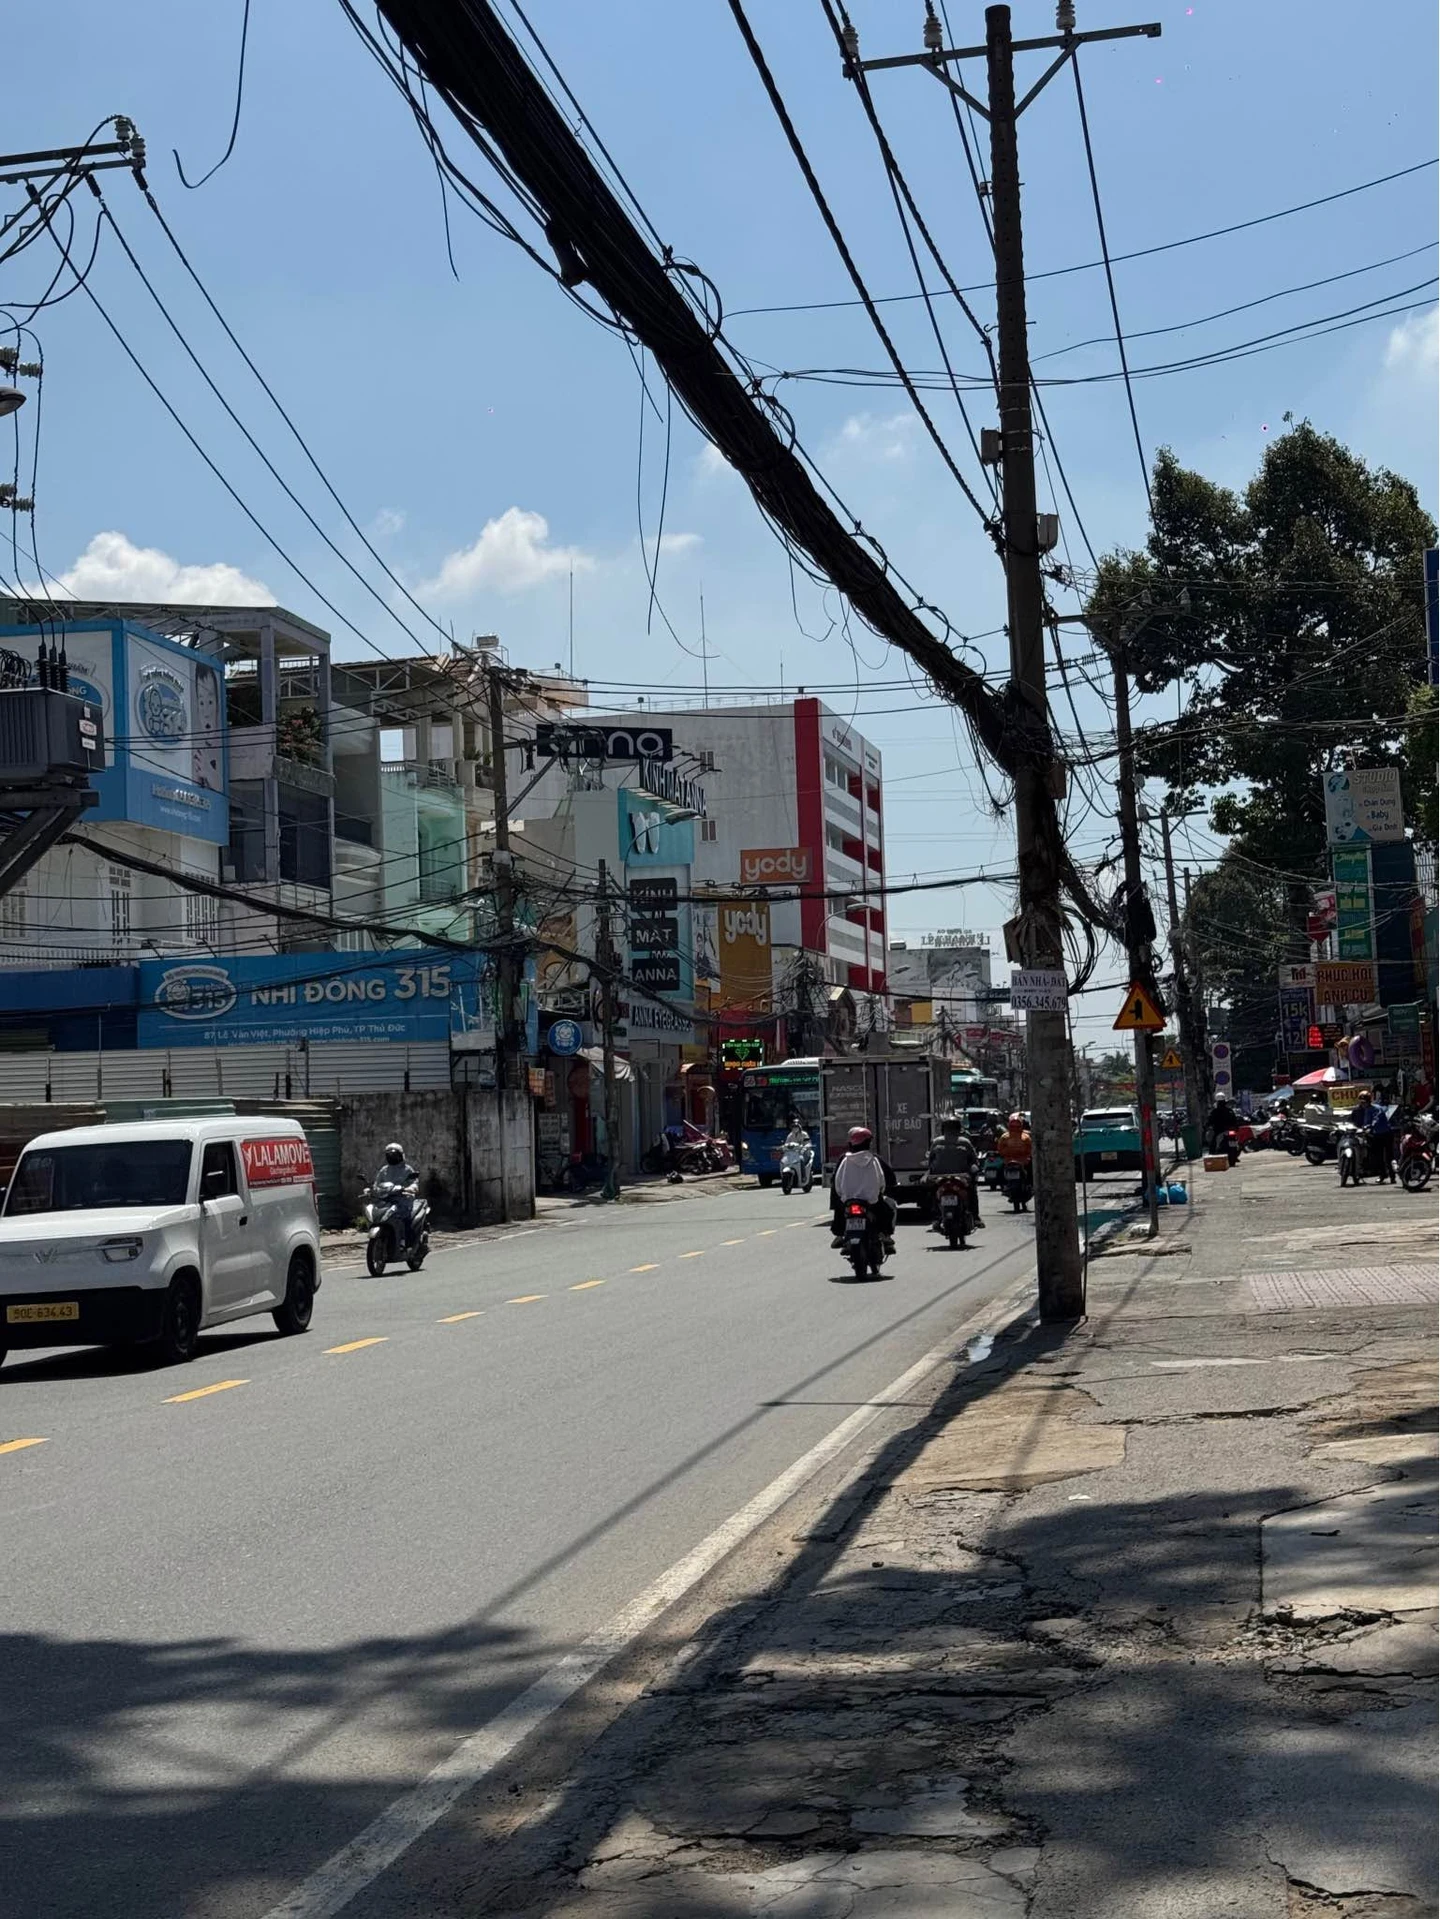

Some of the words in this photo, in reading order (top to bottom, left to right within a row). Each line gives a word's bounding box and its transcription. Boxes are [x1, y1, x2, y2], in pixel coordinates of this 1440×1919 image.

[1354, 771, 1396, 784] STUDIO
[745, 849, 807, 882] yody
[724, 902, 767, 946] yody
[634, 968, 677, 982] ANNA
[251, 985, 296, 1006] NHI
[393, 965, 451, 1000] 315
[1012, 995, 1066, 1010] 0356.345.679
[897, 1103, 908, 1114] XE
[253, 1143, 310, 1167] LALAMOVE
